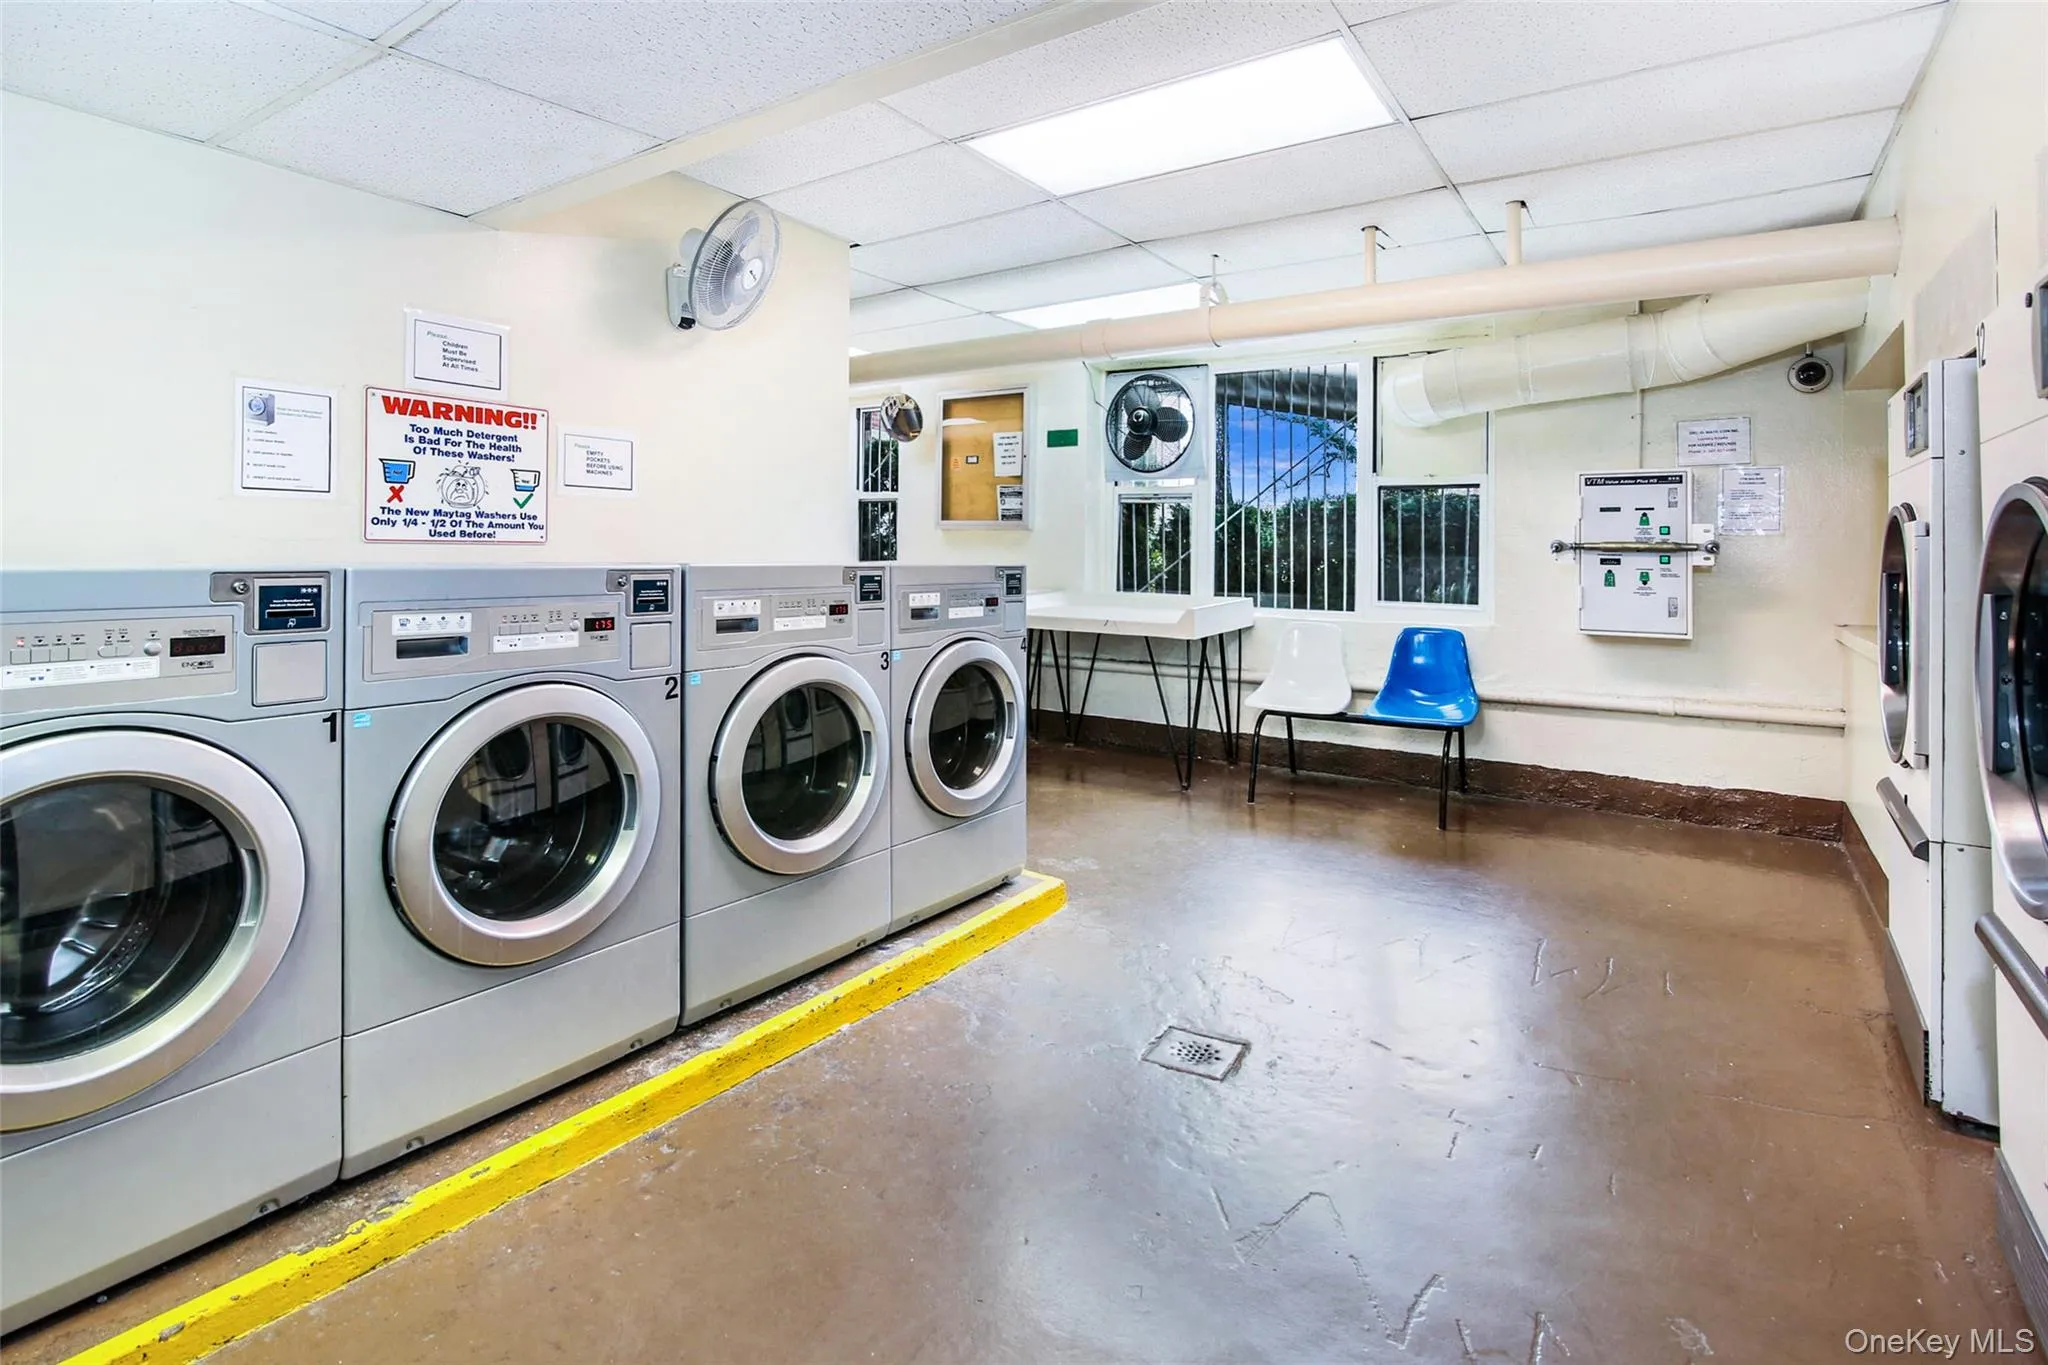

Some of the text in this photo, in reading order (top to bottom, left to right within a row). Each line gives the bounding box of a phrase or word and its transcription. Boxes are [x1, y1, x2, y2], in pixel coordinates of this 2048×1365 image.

[442, 340, 469, 349] Children
[442, 347, 458, 355] Must
[442, 354, 477, 366] Supervised
[381, 395, 537, 430] WARNING!!
[409, 423, 518, 443] Too Much Detergent
[404, 434, 522, 453] Is Bad For The Health
[413, 446, 515, 463] Of These Washers!
[586, 456, 611, 464] POCKETS
[586, 469, 613, 477] MACHINES
[379, 506, 538, 520] The New Maytag Washers Use
[371, 516, 397, 527] Only
[402, 518, 418, 528] 1/4
[430, 519, 447, 528] 1/2
[449, 519, 462, 528] Of
[465, 520, 485, 529] The
[487, 521, 525, 530] Amount
[528, 522, 545, 530] You
[428, 529, 496, 539] Used Before!
[1020, 637, 1026, 652] 4
[880, 651, 889, 670] 3
[665, 676, 678, 700] 2
[322, 712, 337, 742] 1
